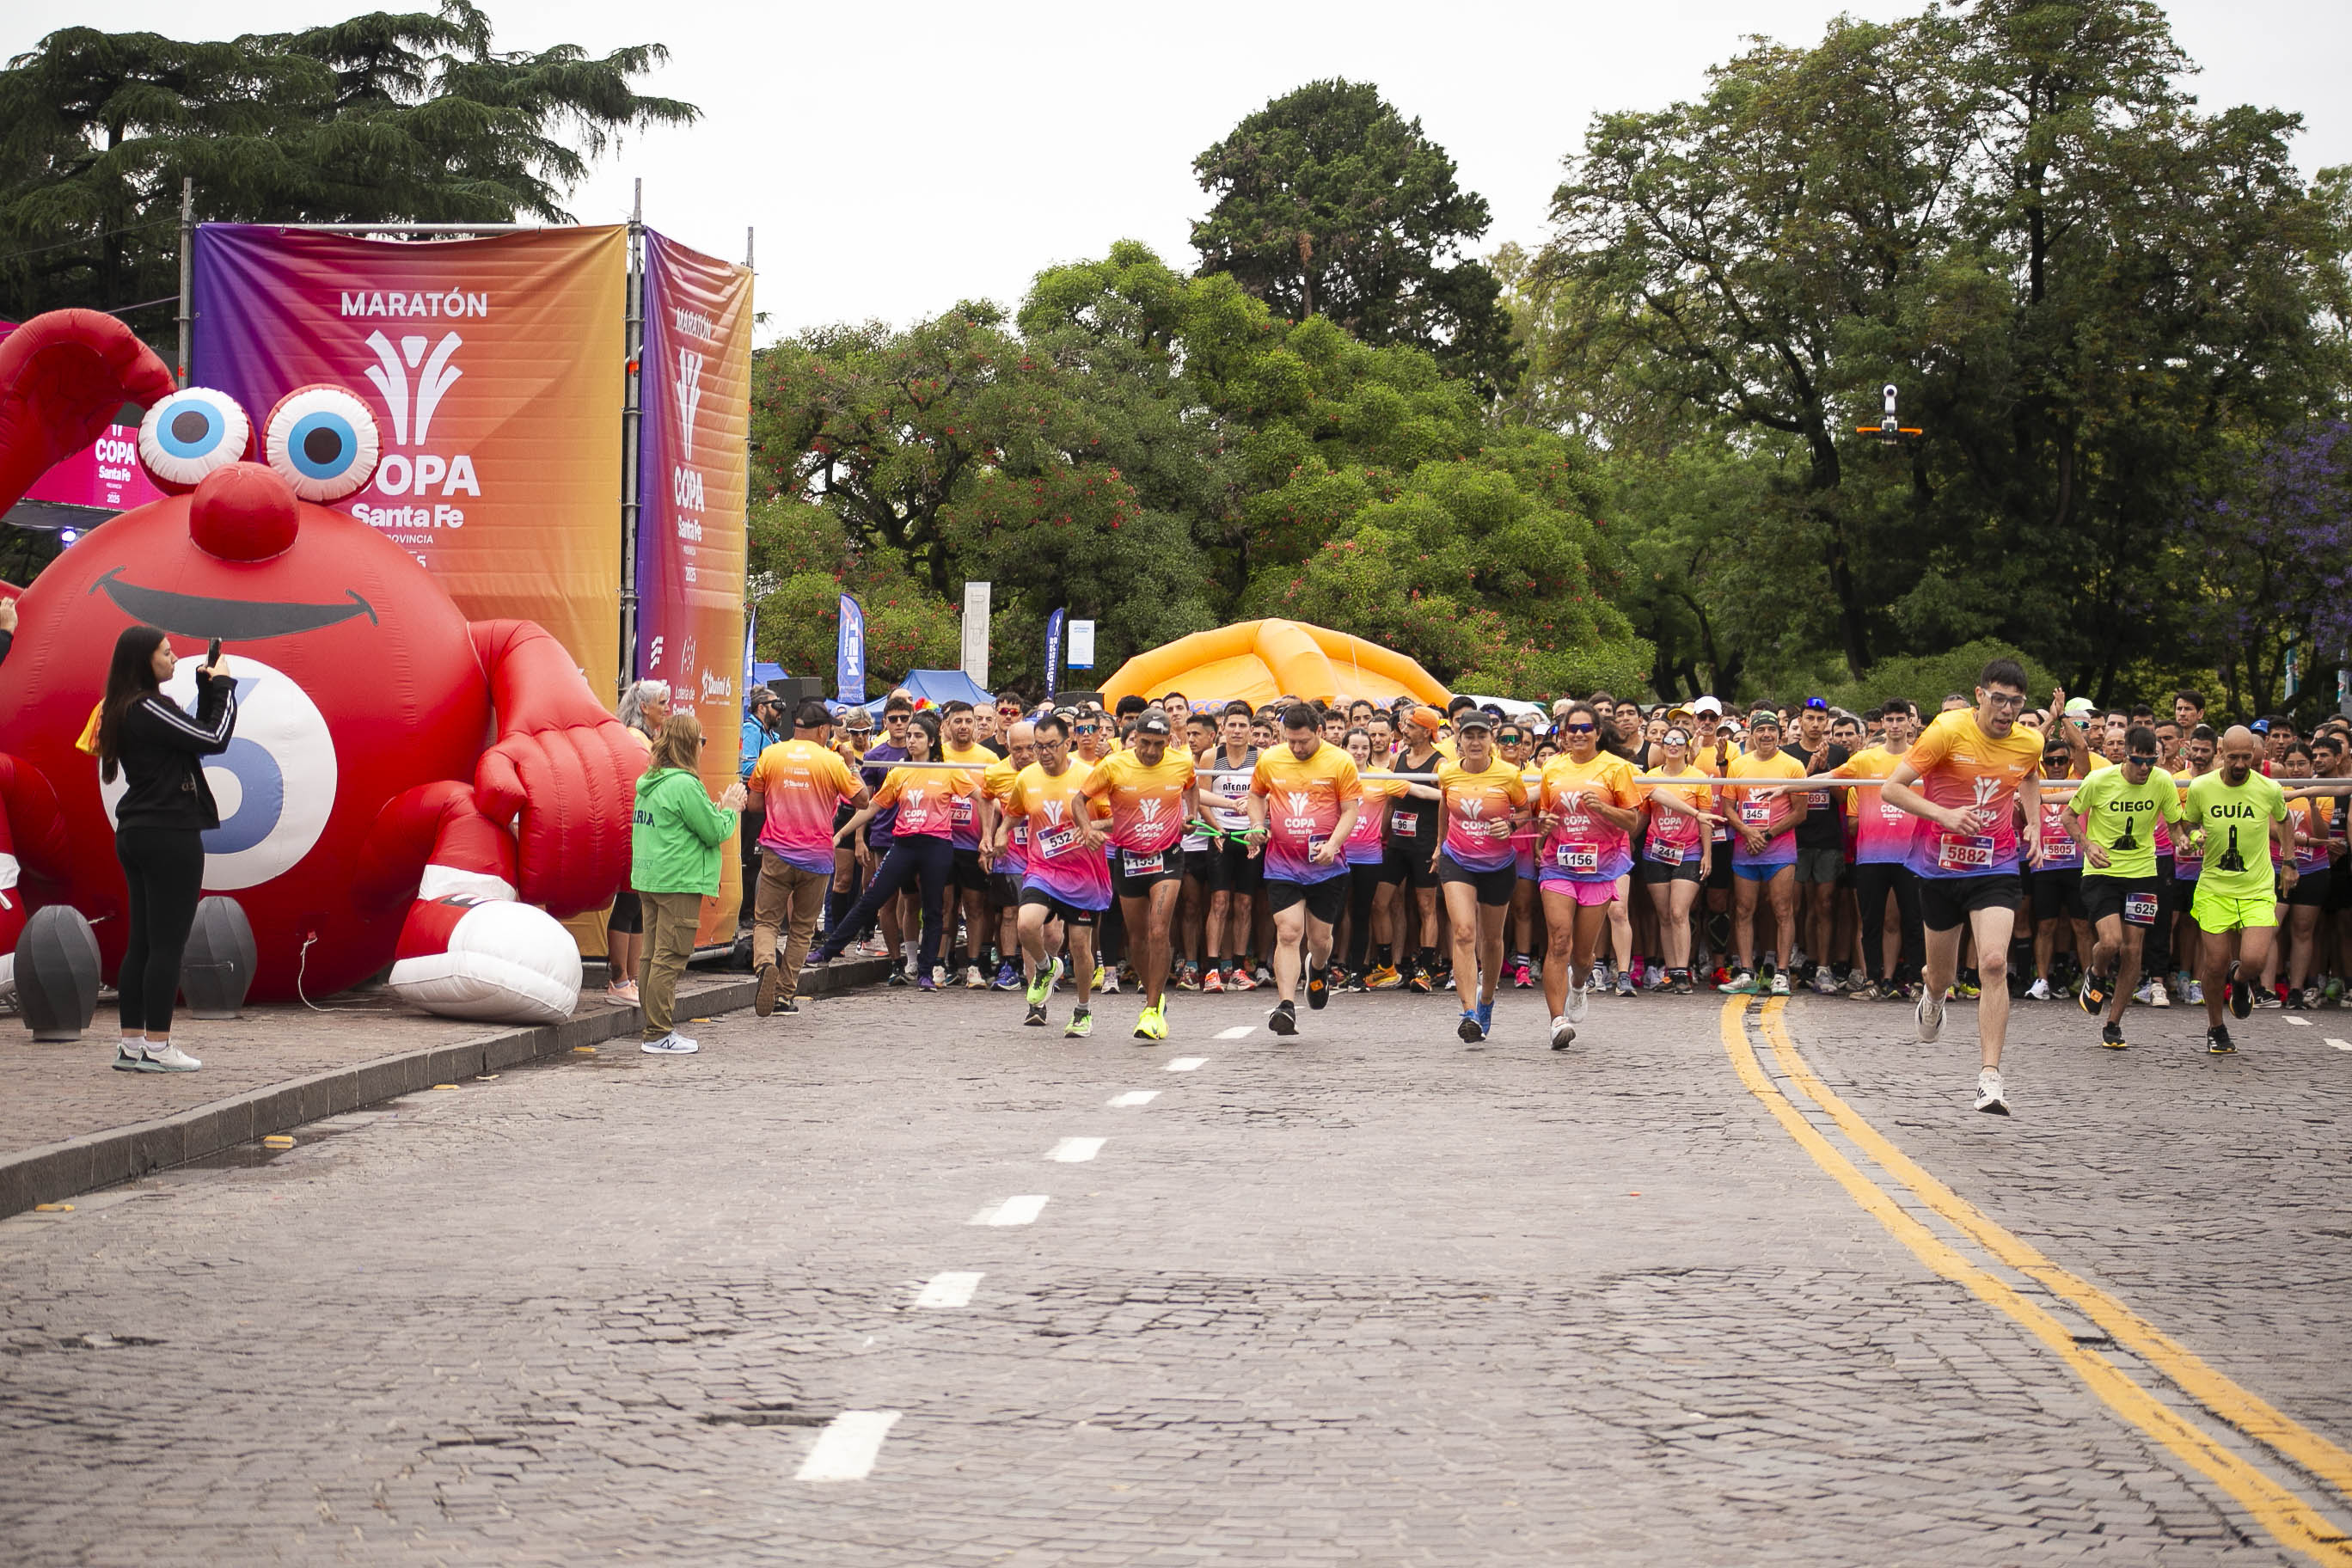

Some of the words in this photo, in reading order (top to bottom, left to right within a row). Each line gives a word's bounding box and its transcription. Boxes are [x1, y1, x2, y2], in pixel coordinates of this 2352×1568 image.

[340, 287, 488, 317] MARATÓN
[676, 307, 712, 340] MARATÓN
[95, 438, 137, 466] COPA
[98, 465, 121, 481] Santa
[121, 468, 132, 481] Fe
[360, 454, 481, 496] OPA
[674, 465, 706, 512] COPA
[352, 503, 431, 528] Santa
[433, 504, 464, 529] Fe
[677, 514, 695, 541] Santa
[694, 518, 702, 542] Fe
[386, 534, 434, 544] OVINCIA
[2110, 799, 2154, 812] CIEGO
[2210, 802, 2255, 819] GUÍA
[904, 809, 928, 819] COPA
[1563, 815, 1591, 825] COPA
[1746, 810, 1763, 818] 845
[1284, 818, 1316, 829] COPA
[1398, 820, 1407, 830] 96
[1658, 817, 1682, 826] COPA
[1049, 832, 1072, 848] 532
[1658, 846, 1676, 858] 241
[1947, 846, 1988, 863] 5882
[2048, 845, 2072, 854] 5805
[1562, 854, 1593, 866] 1156
[2134, 903, 2156, 916] 625
